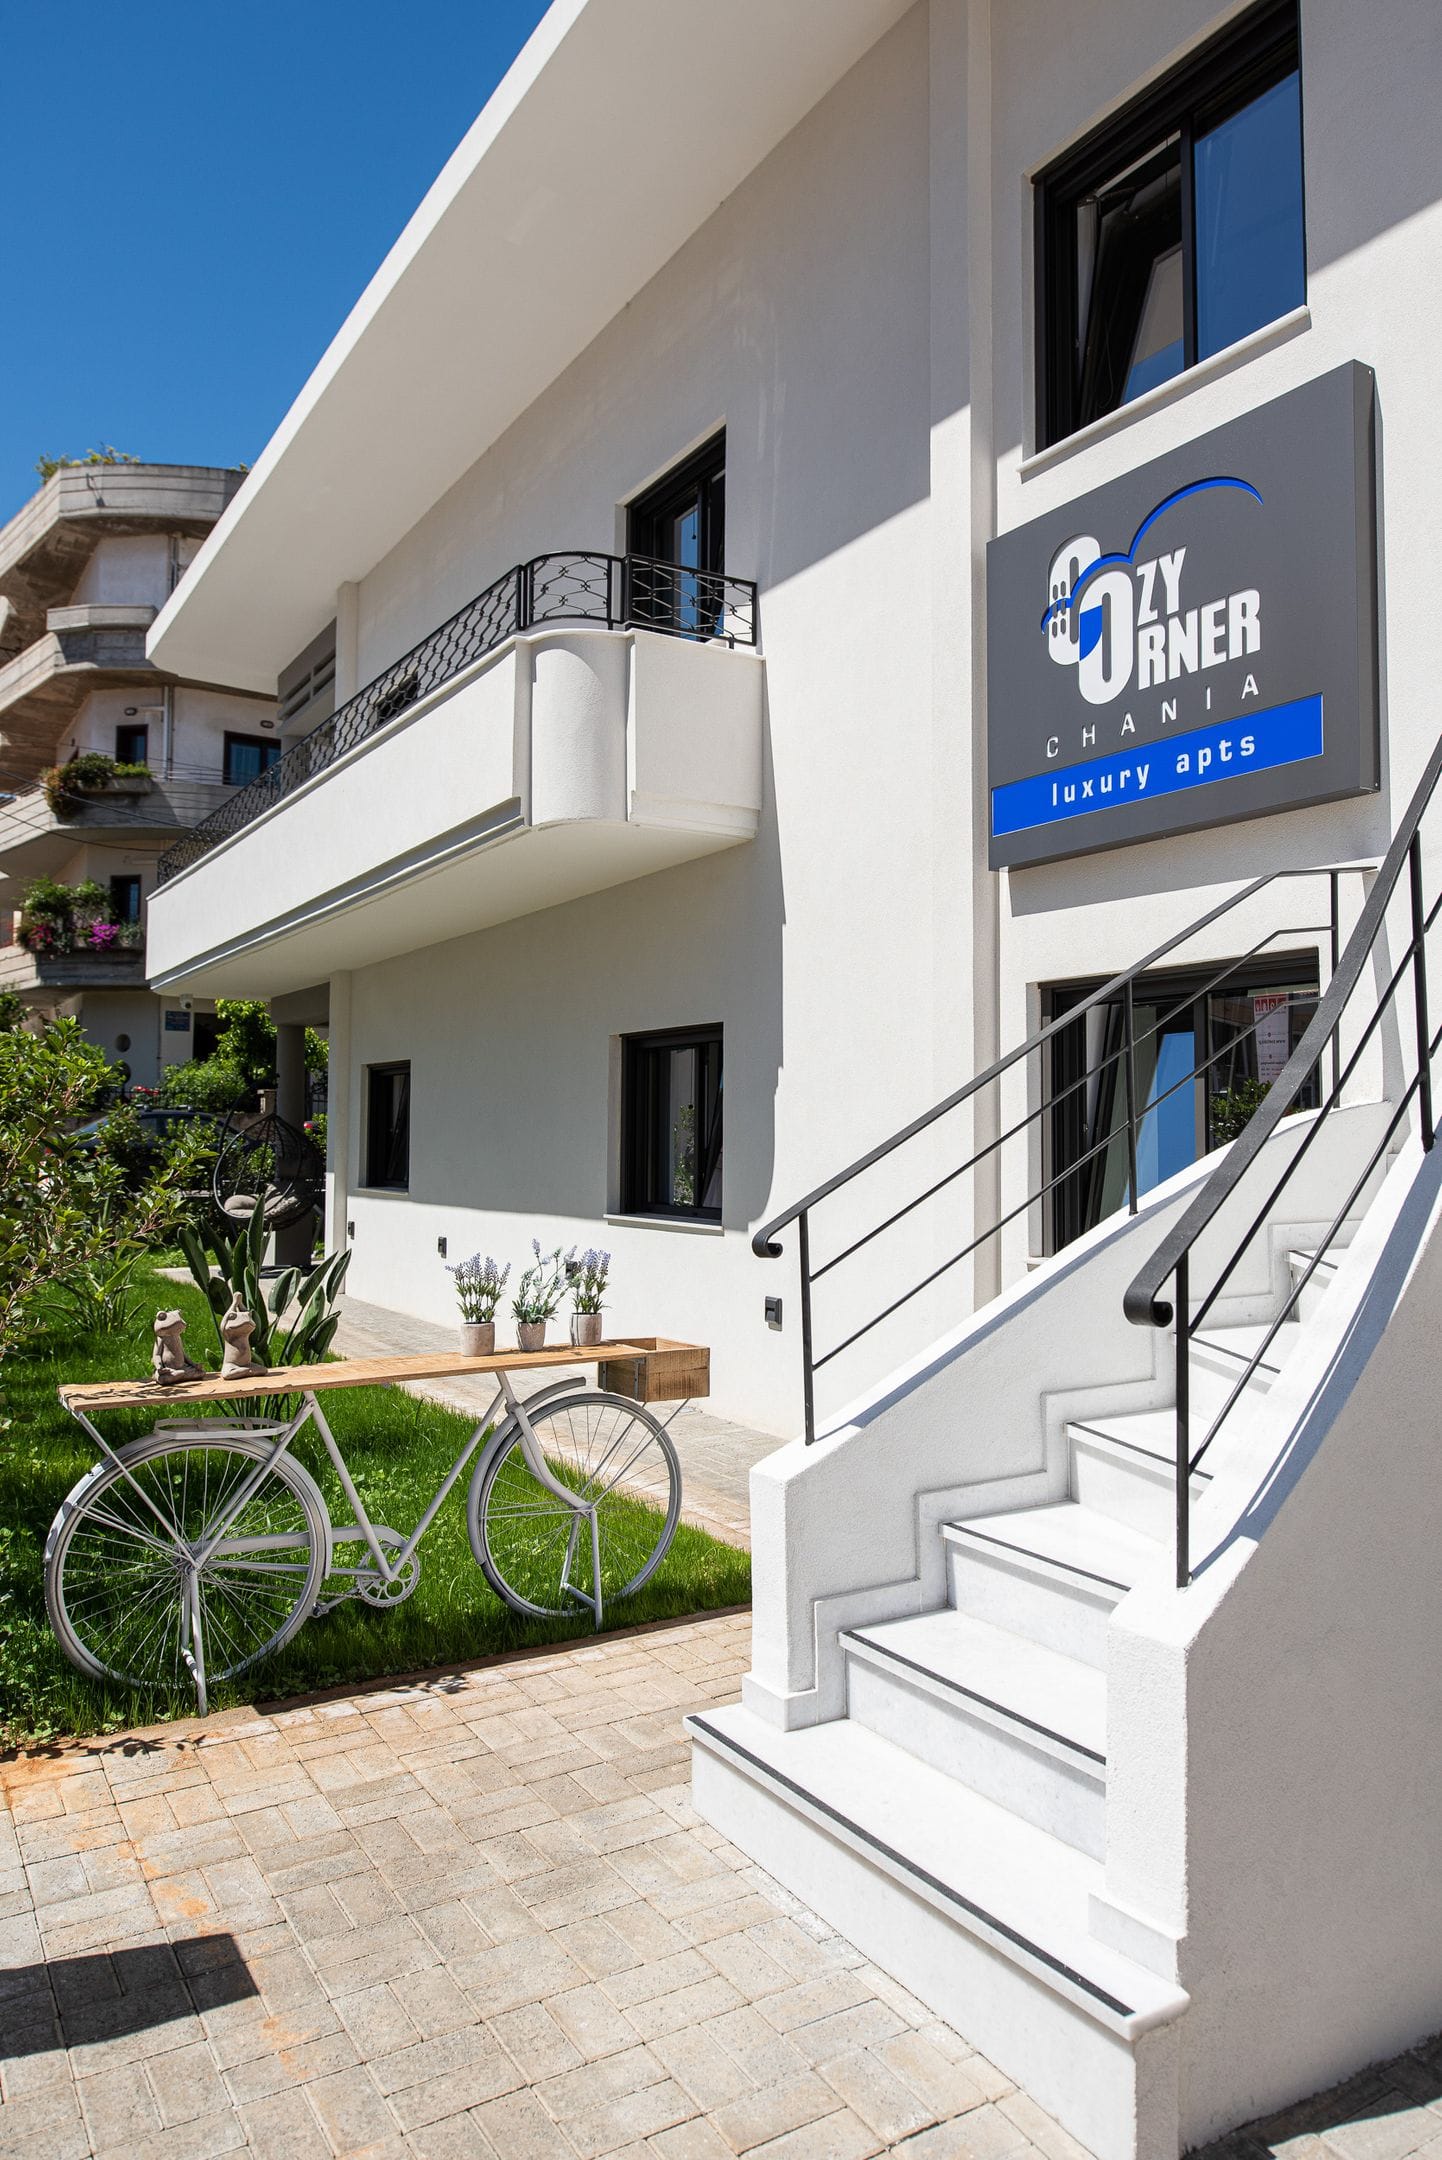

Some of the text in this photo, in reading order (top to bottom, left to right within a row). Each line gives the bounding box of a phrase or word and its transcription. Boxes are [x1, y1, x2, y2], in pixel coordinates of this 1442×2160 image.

[1046, 673, 1260, 758] CHANIA
[1052, 735, 1255, 806] luxury apts
